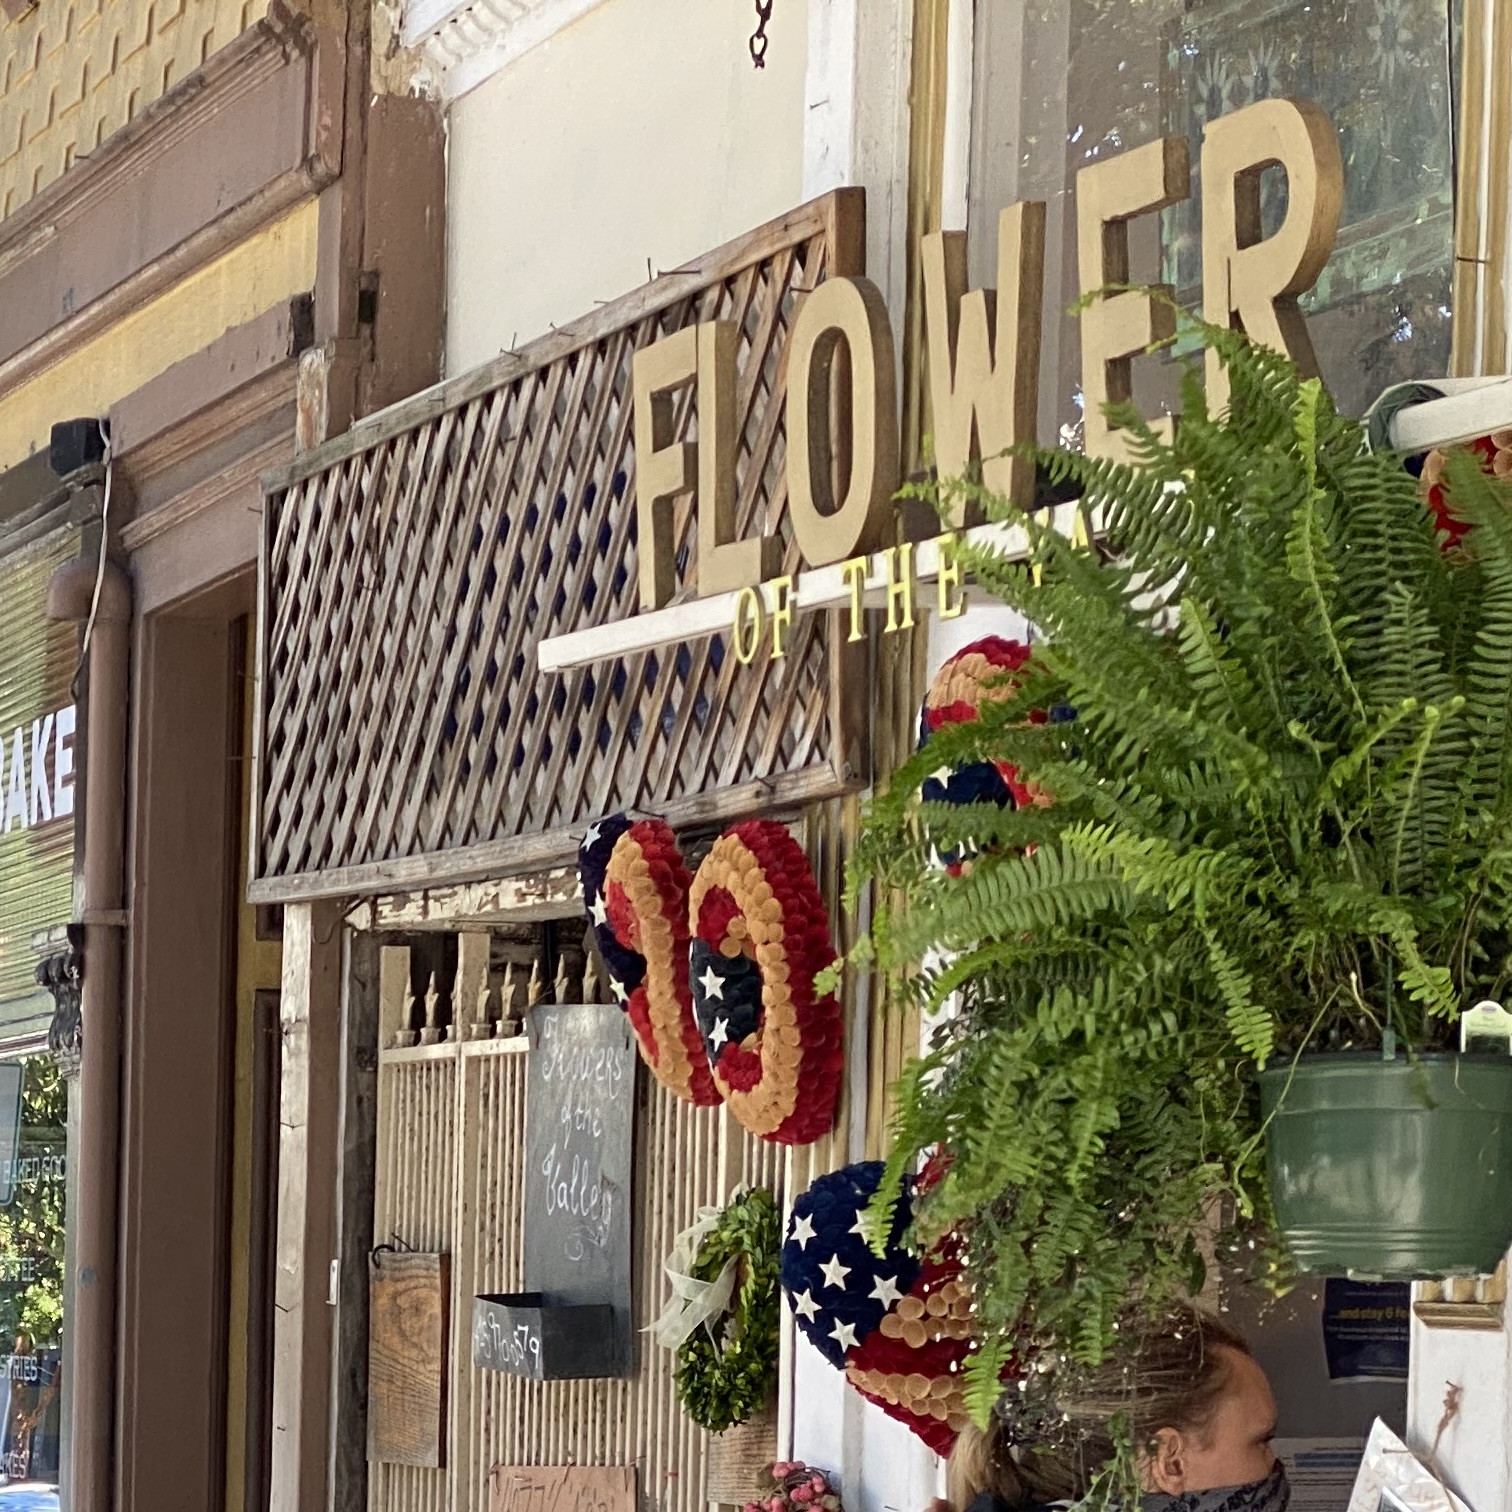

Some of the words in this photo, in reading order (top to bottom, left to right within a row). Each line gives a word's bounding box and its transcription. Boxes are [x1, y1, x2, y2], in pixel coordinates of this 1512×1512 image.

[632, 98, 1344, 612] FLOWER
[733, 574, 794, 664] OF
[841, 533, 968, 643] THE
